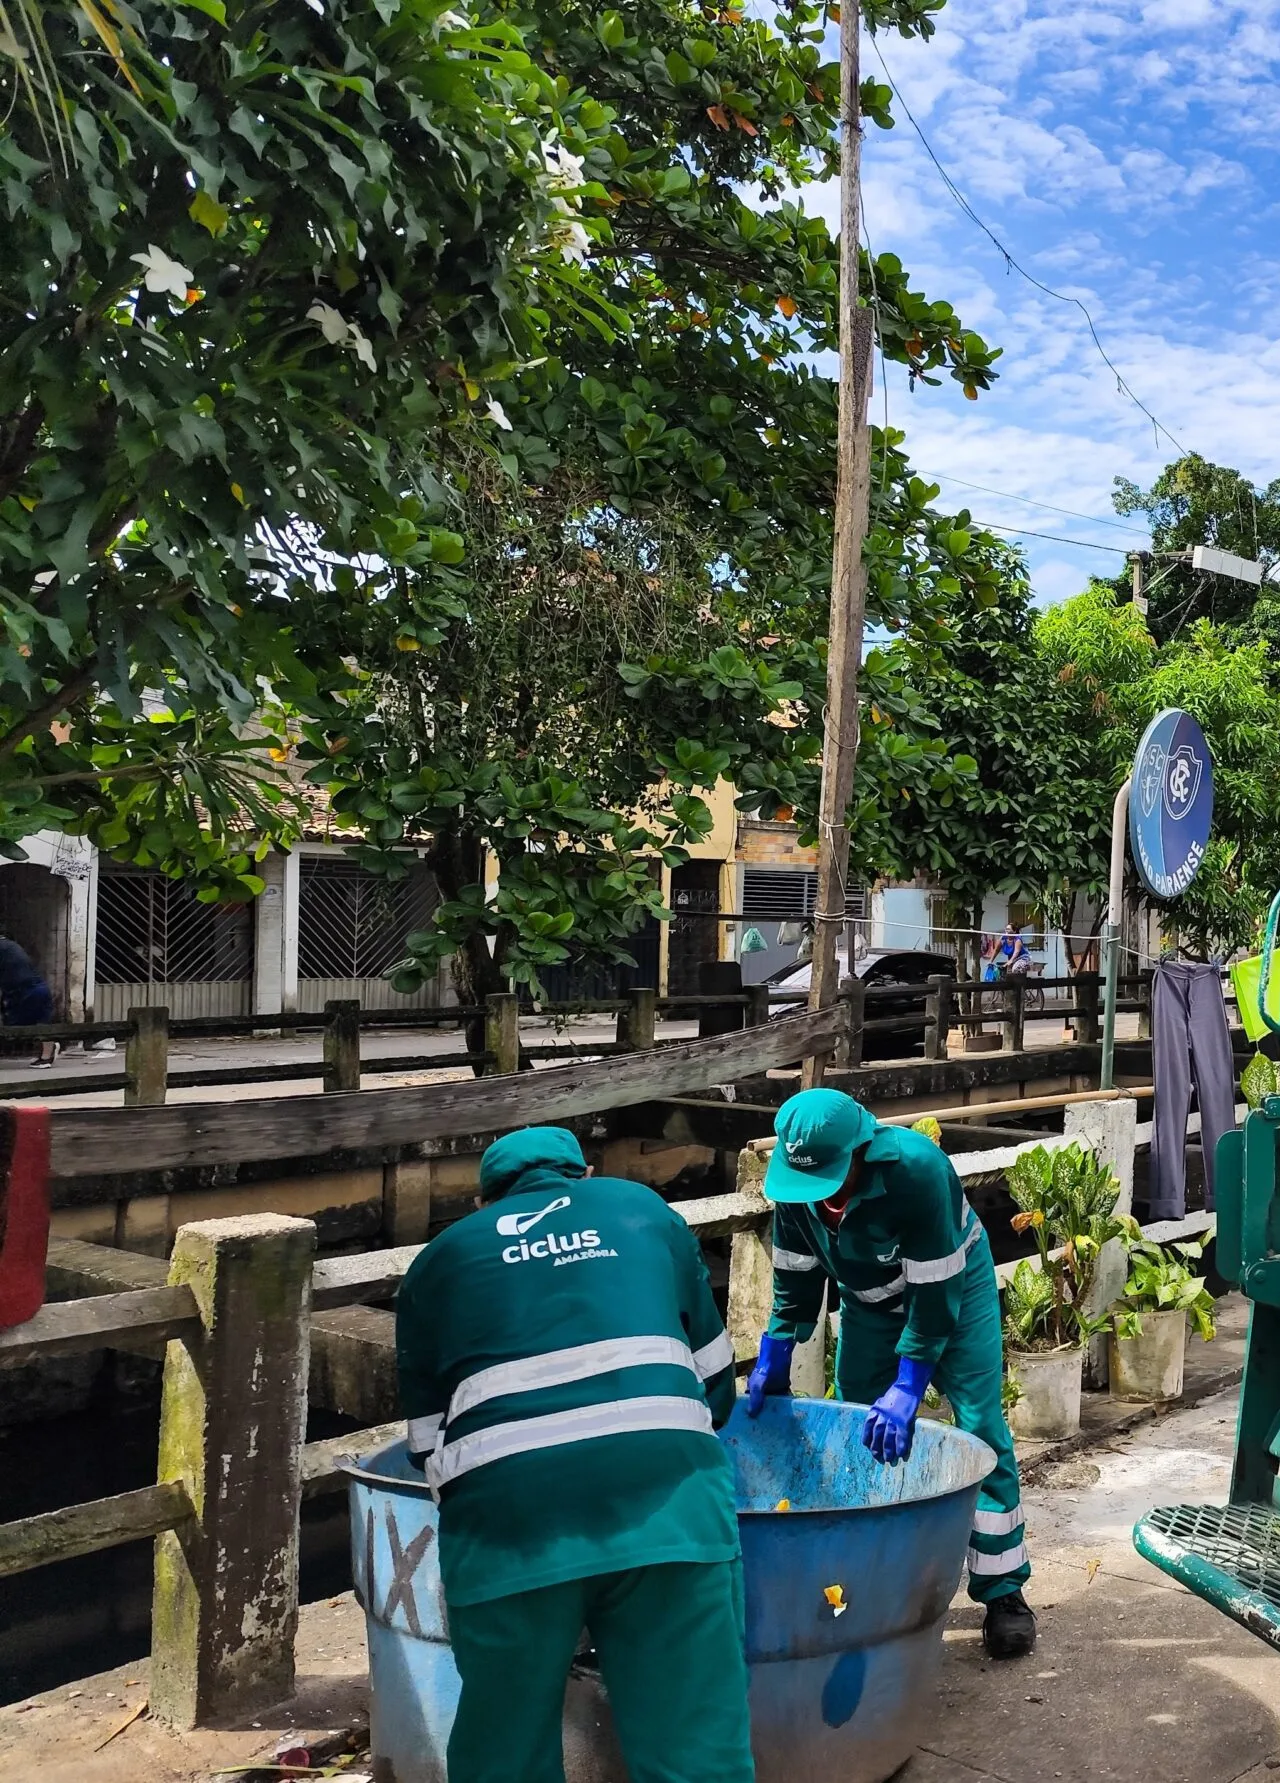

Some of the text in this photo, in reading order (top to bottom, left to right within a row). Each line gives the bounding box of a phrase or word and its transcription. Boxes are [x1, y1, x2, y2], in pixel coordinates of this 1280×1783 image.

[1155, 840, 1204, 895] PARAENSE
[502, 1229, 602, 1264] ciclus
[553, 1248, 619, 1267] AMAZÔNIA
